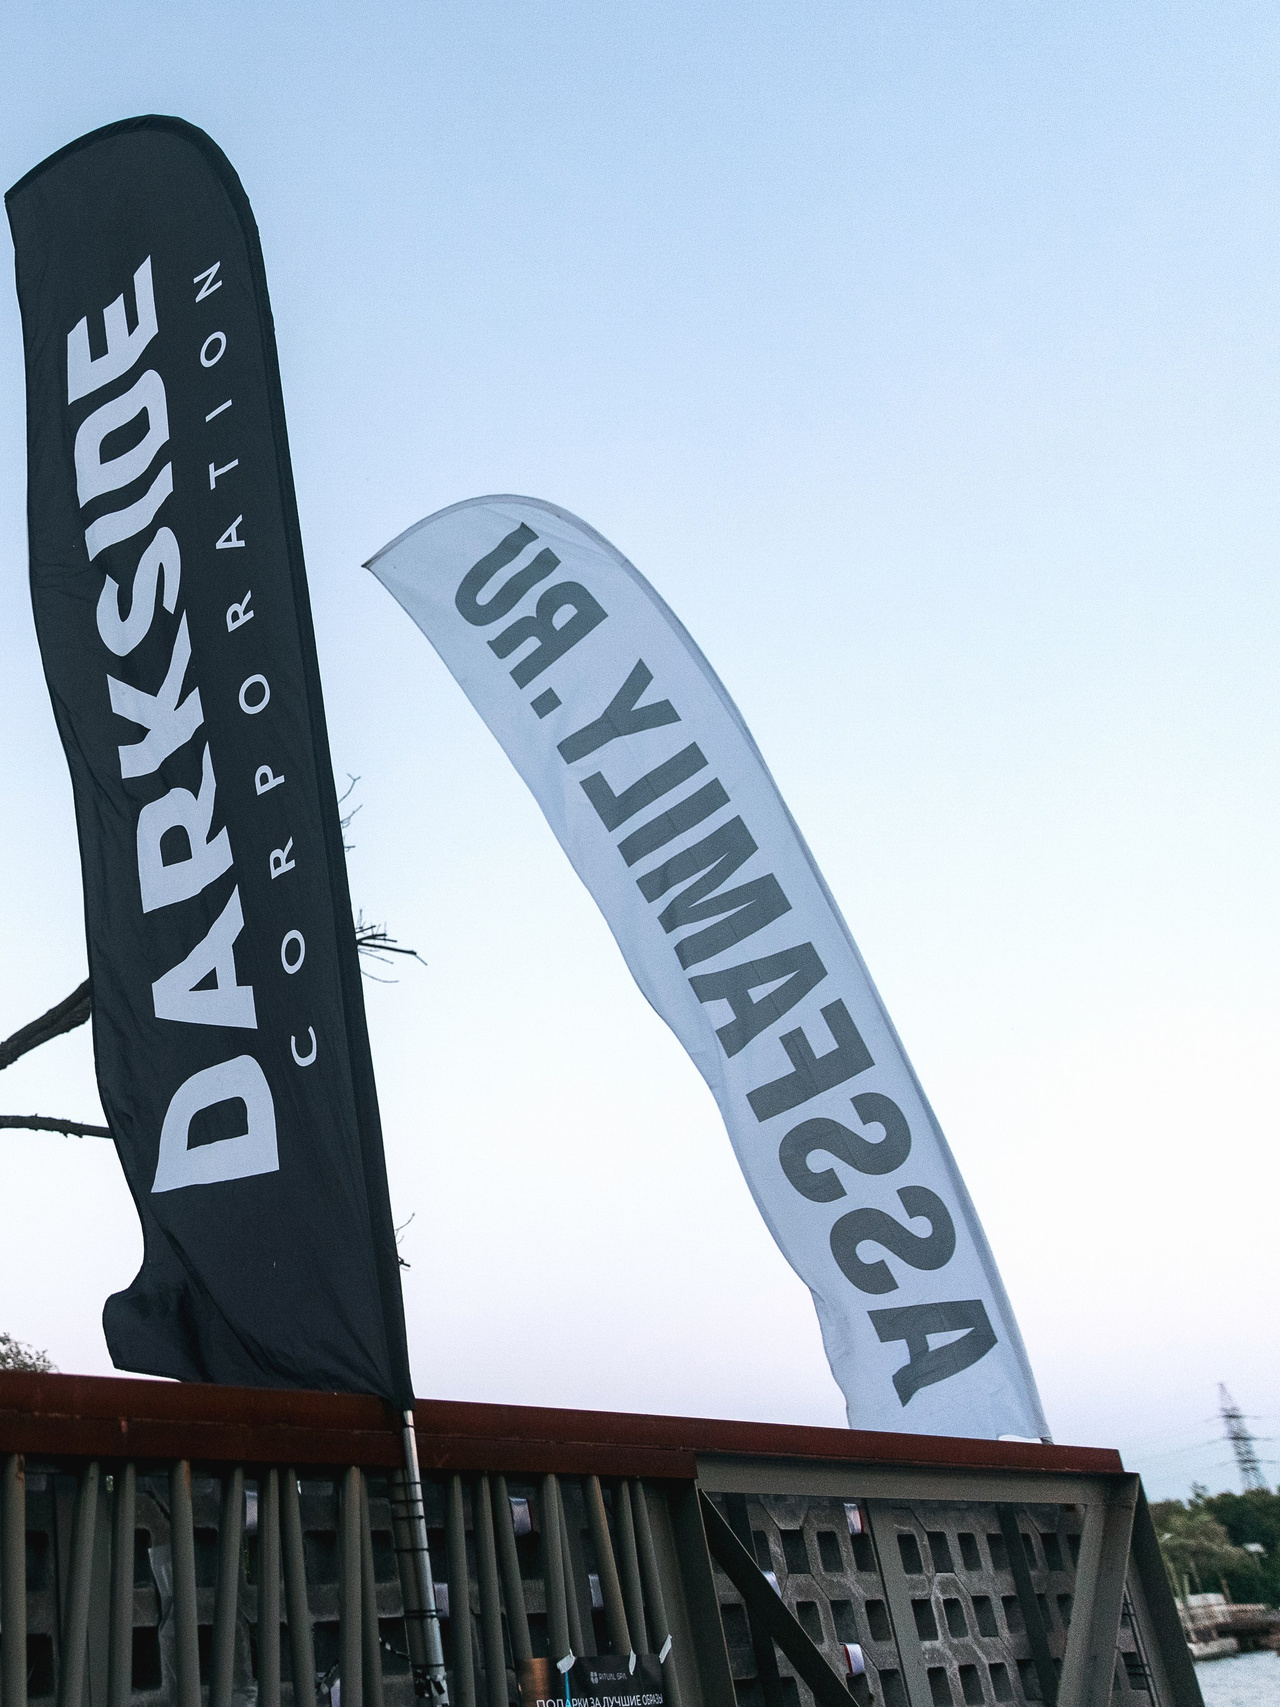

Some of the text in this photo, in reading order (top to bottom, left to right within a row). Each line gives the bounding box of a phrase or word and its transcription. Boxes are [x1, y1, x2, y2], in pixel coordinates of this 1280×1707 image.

[67, 255, 280, 1194] DARKSIDE
[193, 261, 319, 1067] CORPORATION
[536, 1693, 664, 1707] ПОДАРКИ ЗА ЛУЧШИЕ ОБРАЗЫ
